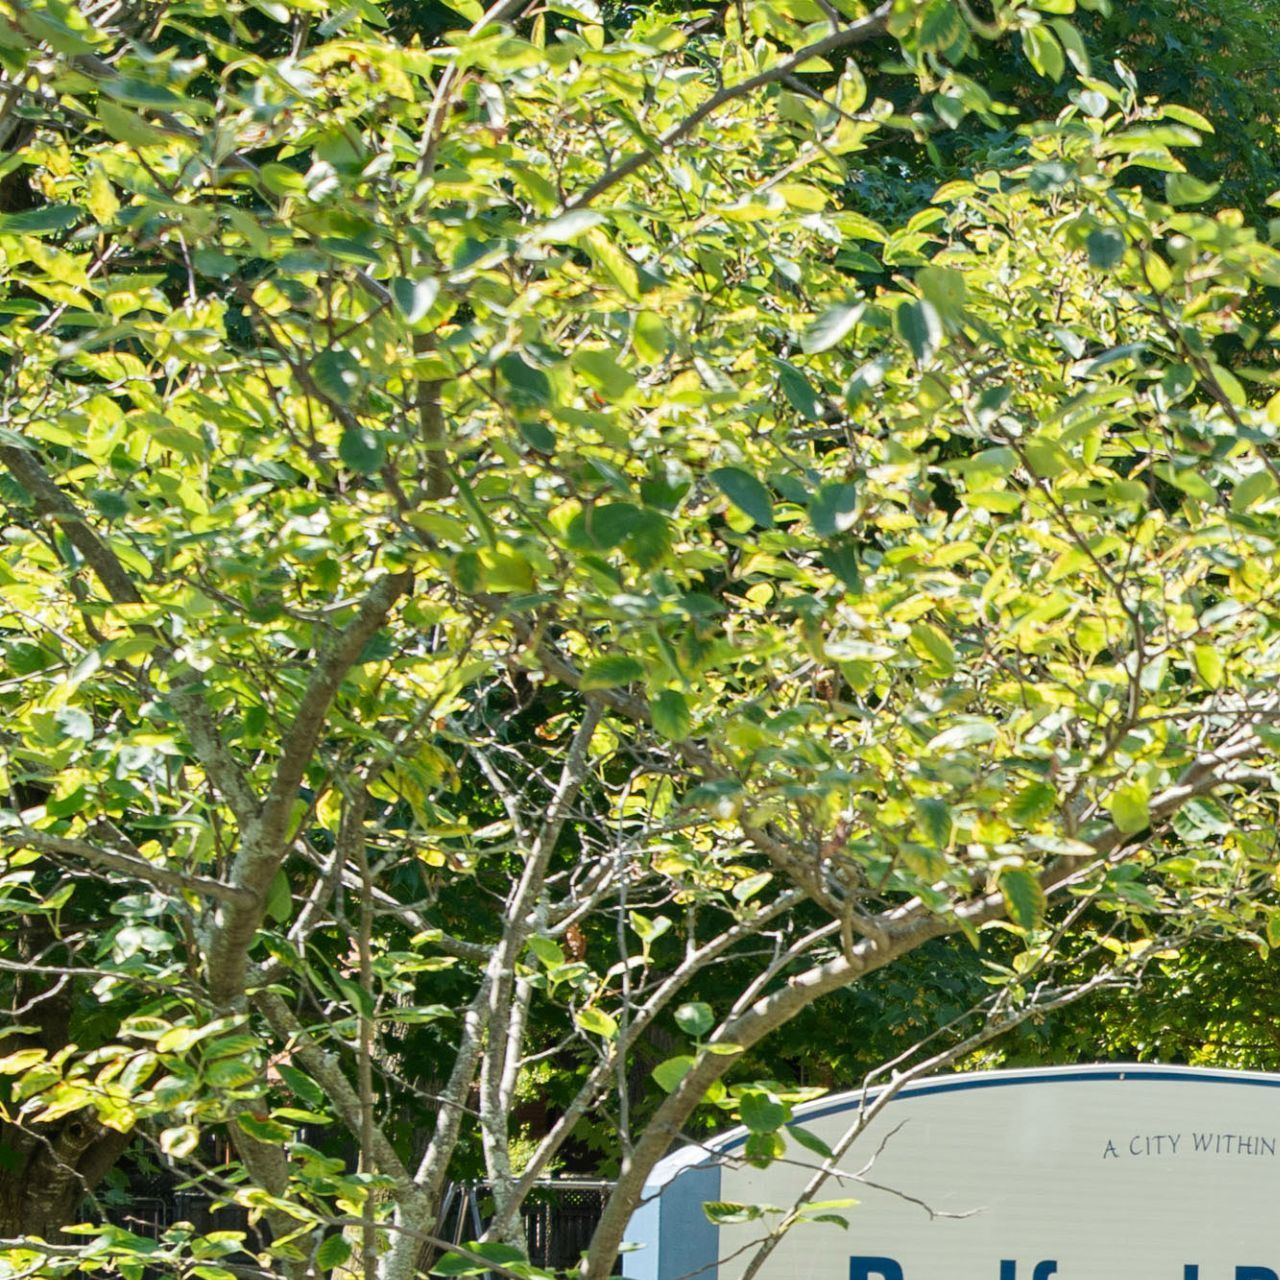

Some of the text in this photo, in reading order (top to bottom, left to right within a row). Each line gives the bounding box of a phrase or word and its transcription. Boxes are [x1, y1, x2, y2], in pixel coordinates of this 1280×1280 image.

[1103, 1139, 1120, 1159] A
[1129, 1134, 1181, 1156] CITY
[1192, 1132, 1275, 1157] WITHIN
